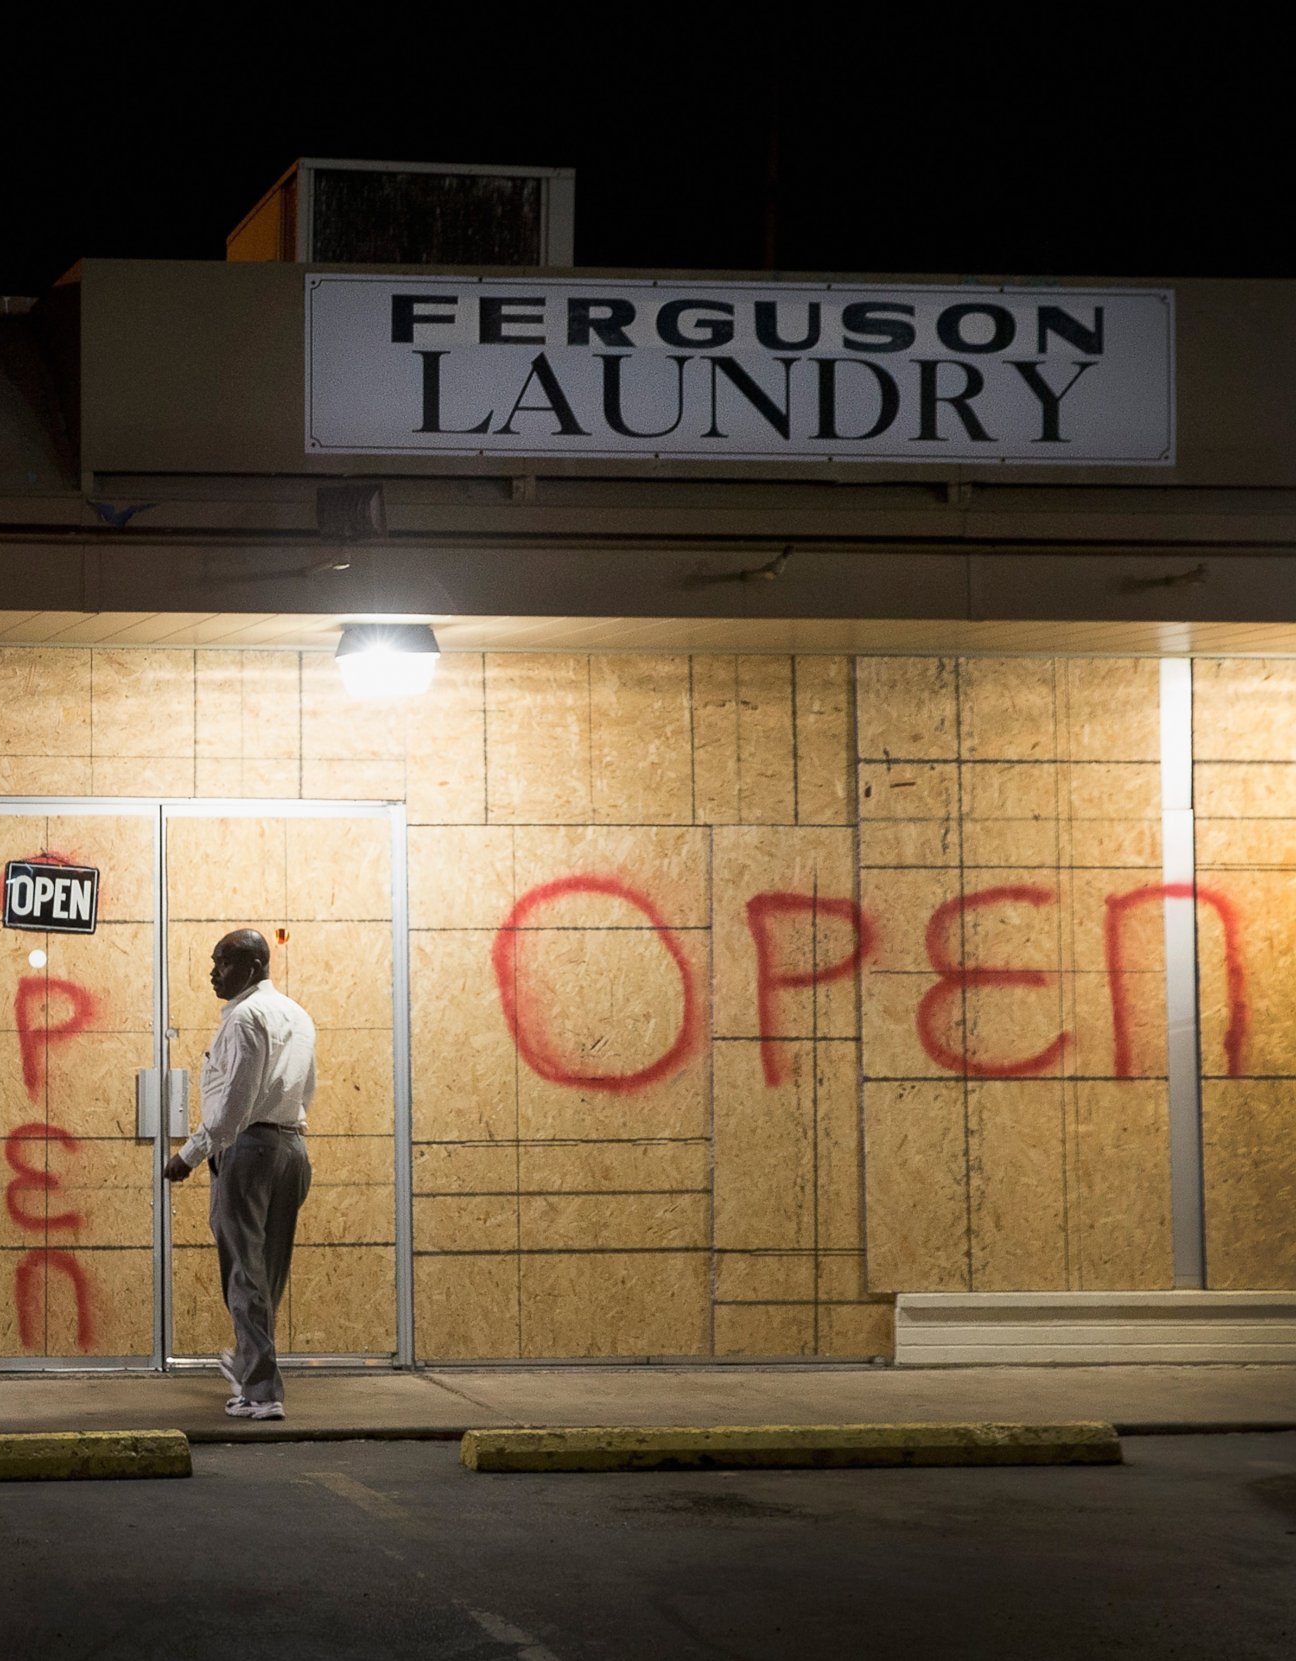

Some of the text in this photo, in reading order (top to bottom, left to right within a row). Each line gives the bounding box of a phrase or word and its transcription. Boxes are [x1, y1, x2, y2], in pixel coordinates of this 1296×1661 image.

[390, 294, 1105, 355] FERGUSON
[410, 349, 1098, 443] LAUNDRY
[11, 875, 92, 920] OPEN
